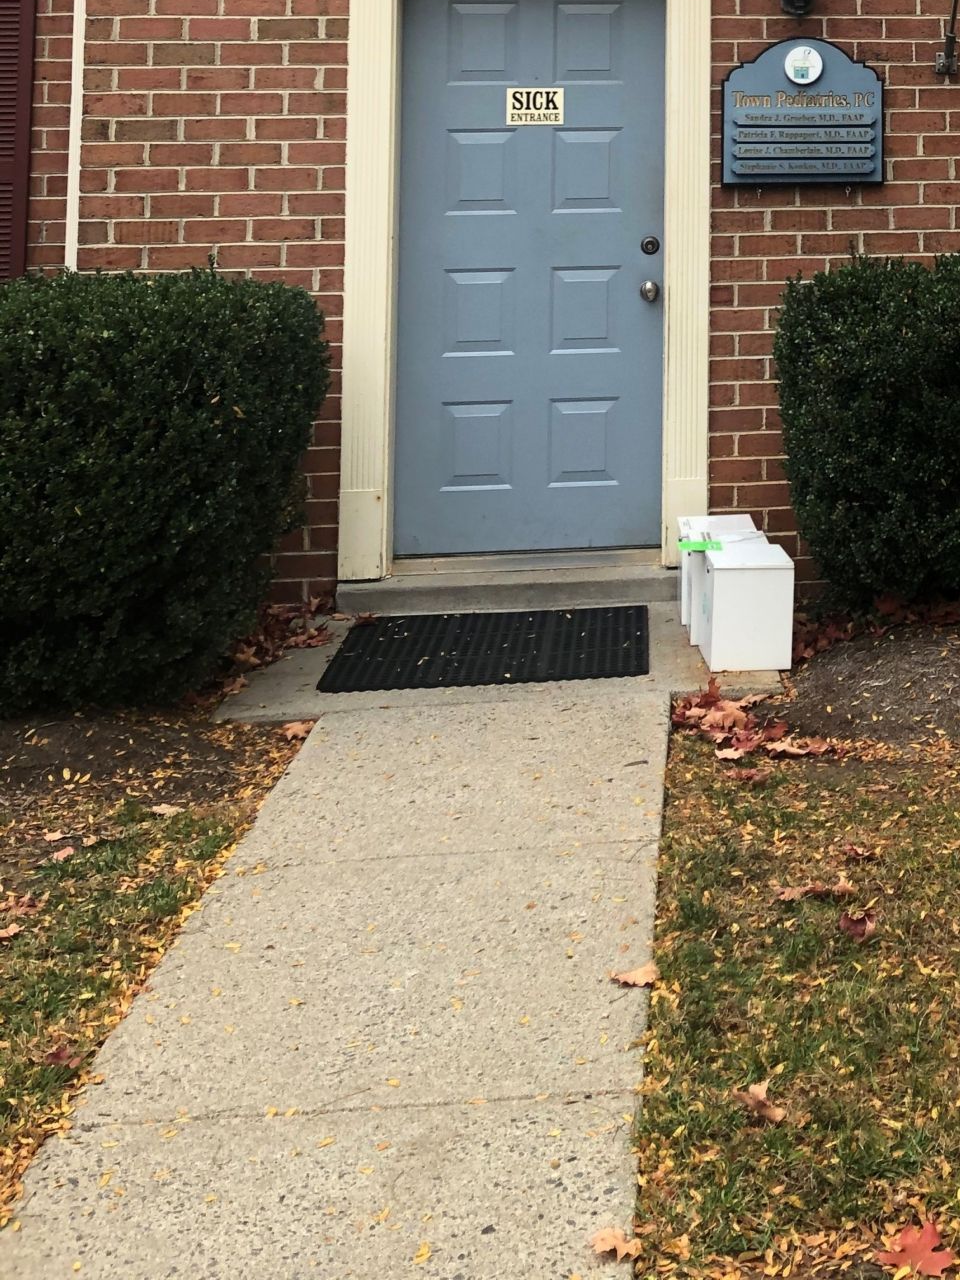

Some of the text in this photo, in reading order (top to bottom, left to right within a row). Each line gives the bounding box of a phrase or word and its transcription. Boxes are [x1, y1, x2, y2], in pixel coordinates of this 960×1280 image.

[512, 91, 559, 110] SICK
[732, 90, 875, 109] Town Pediatrics, PC
[510, 112, 560, 122] ENTRANCE
[841, 114, 865, 122] FAAP
[846, 130, 870, 139] FAAP
[847, 146, 870, 155] FAAP
